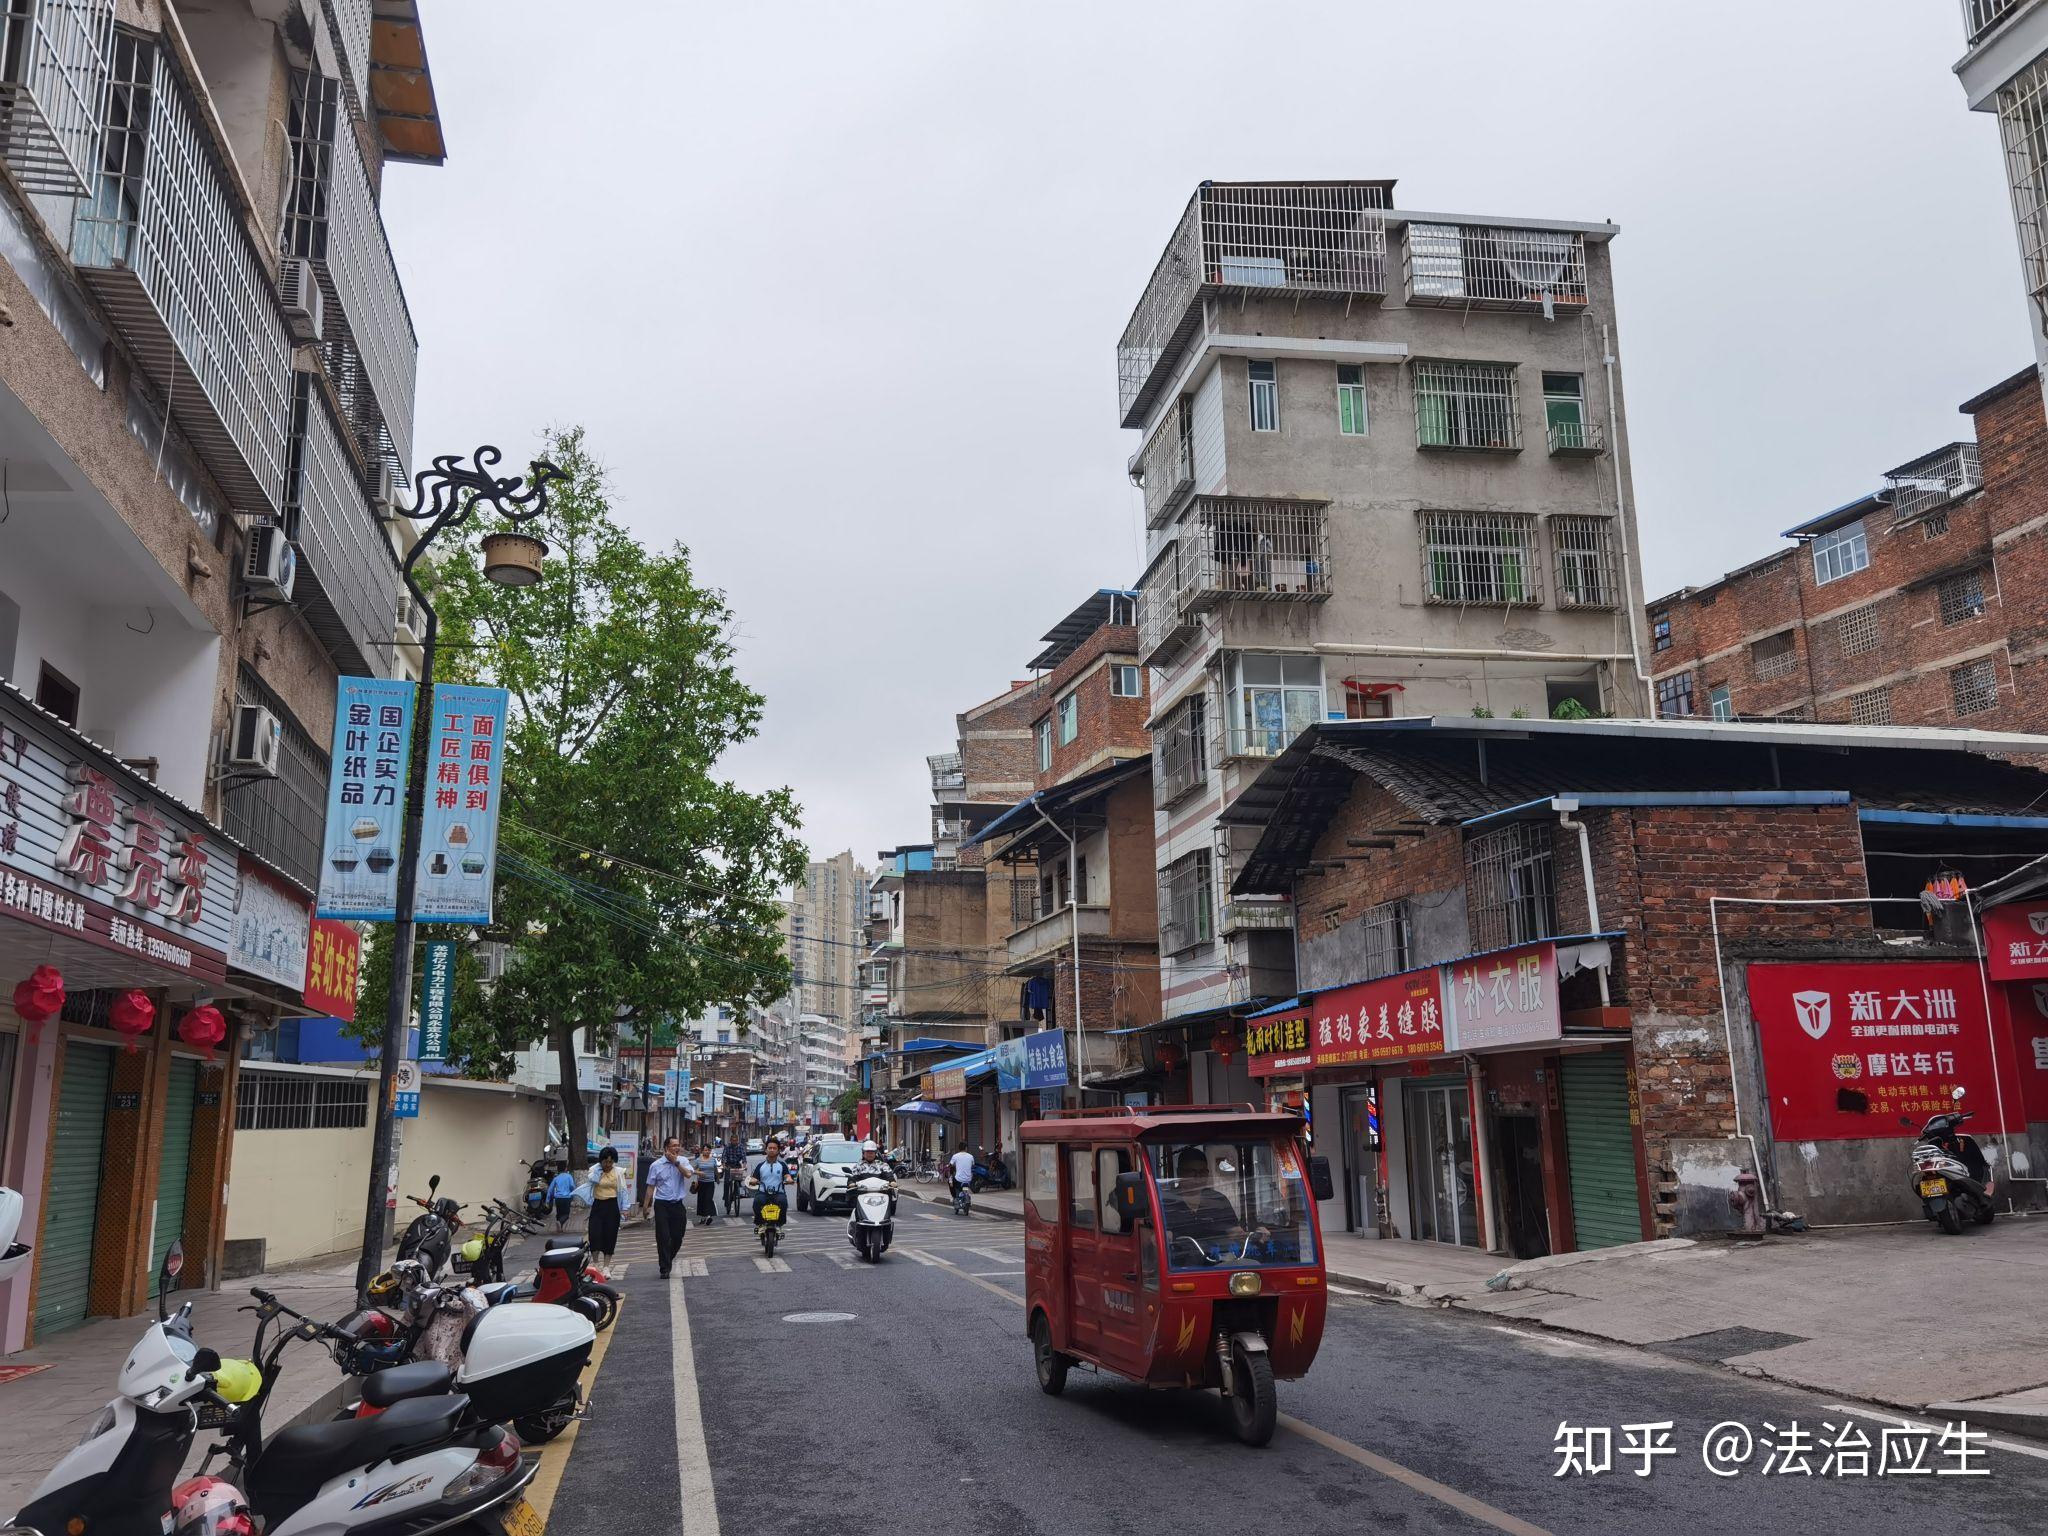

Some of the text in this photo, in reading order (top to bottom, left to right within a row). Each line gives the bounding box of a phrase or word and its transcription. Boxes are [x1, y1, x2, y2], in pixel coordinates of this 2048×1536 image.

[340, 703, 372, 806] 金叶纸品
[373, 705, 403, 806] 国企实力
[434, 713, 464, 810] 工匠精神
[465, 714, 495, 812] 面面俱到
[1462, 953, 1545, 1022] 补衣服
[1848, 988, 1957, 1021] 新大洲
[1317, 997, 1441, 1046] 猛犸象美缝胶
[1850, 1023, 1960, 1038] 全球更耐用的电动车
[1866, 1050, 1955, 1077] 摩达车行
[1625, 1067, 1641, 1126] 补衣服
